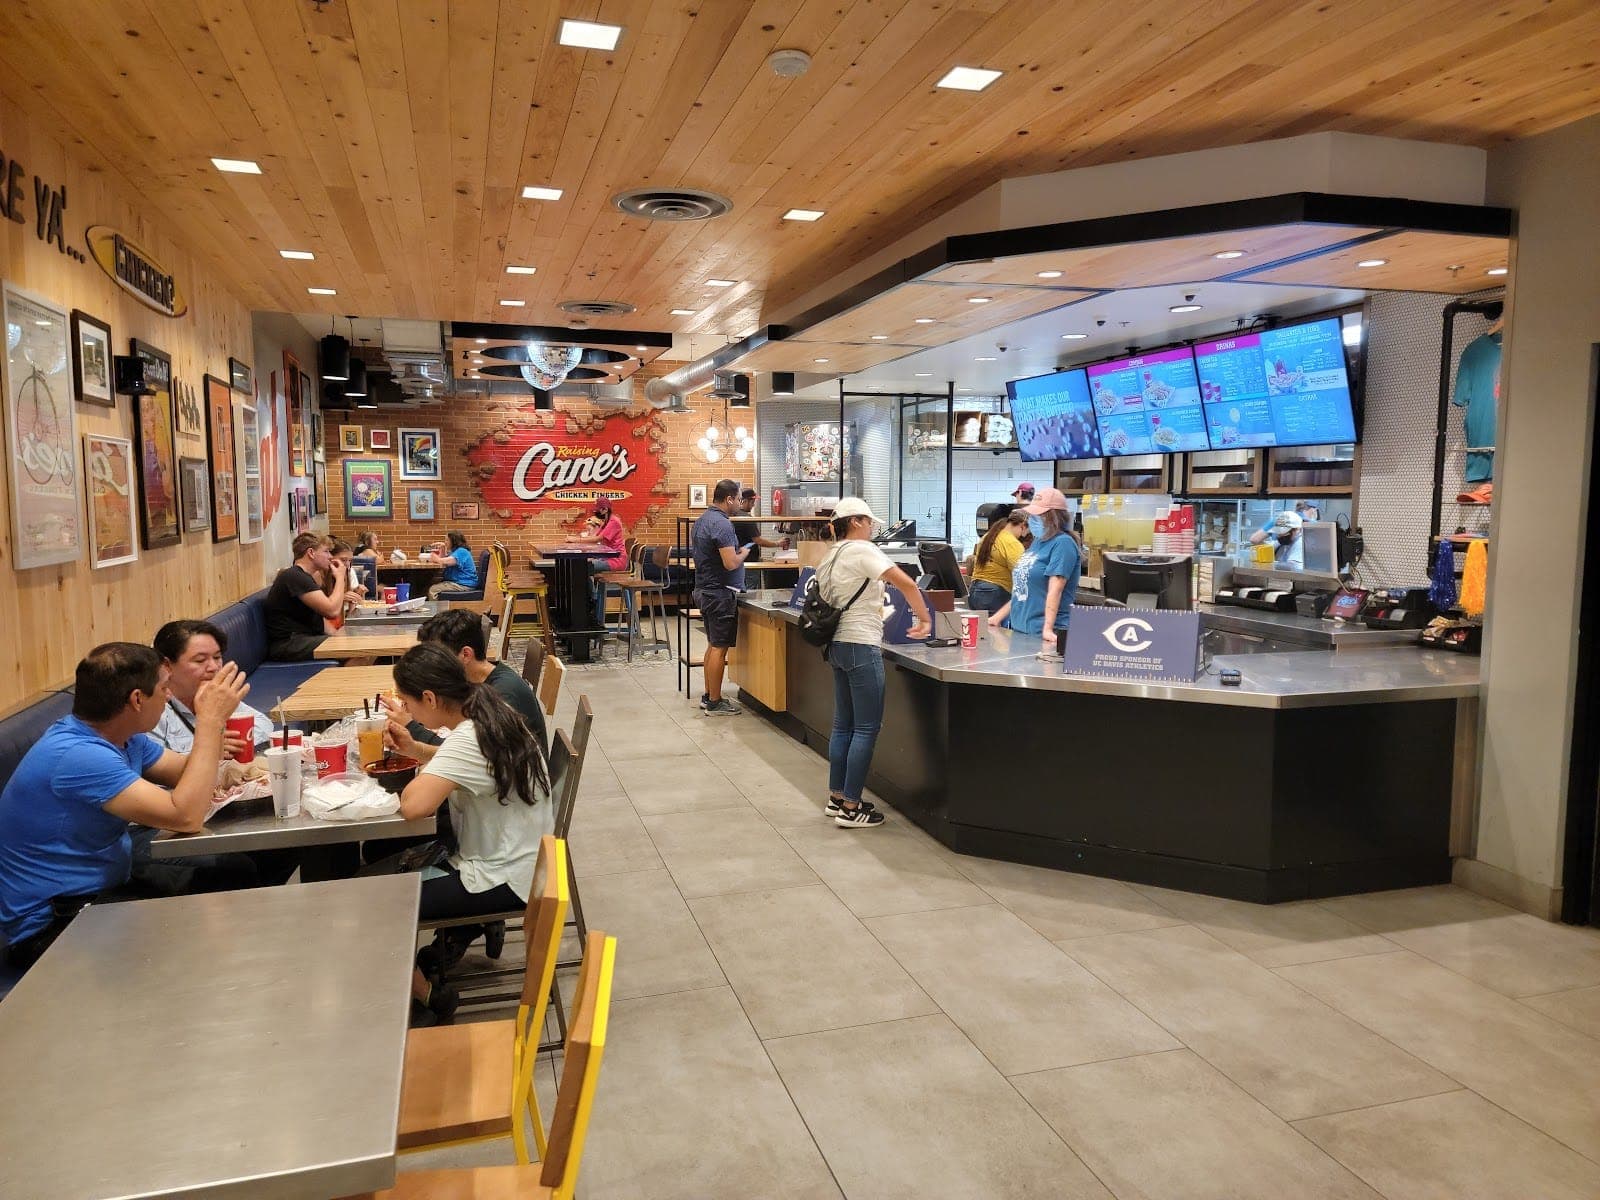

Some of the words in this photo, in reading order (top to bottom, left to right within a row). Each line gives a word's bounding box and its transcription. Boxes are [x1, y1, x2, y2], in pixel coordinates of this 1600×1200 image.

[557, 446, 600, 458] Raising
[513, 442, 637, 500] Cane's
[555, 491, 588, 499] CHICKEN
[592, 491, 625, 499] FINGERS
[1119, 655, 1152, 663] SPONSOR
[1125, 662, 1164, 671] ATHLETICS
